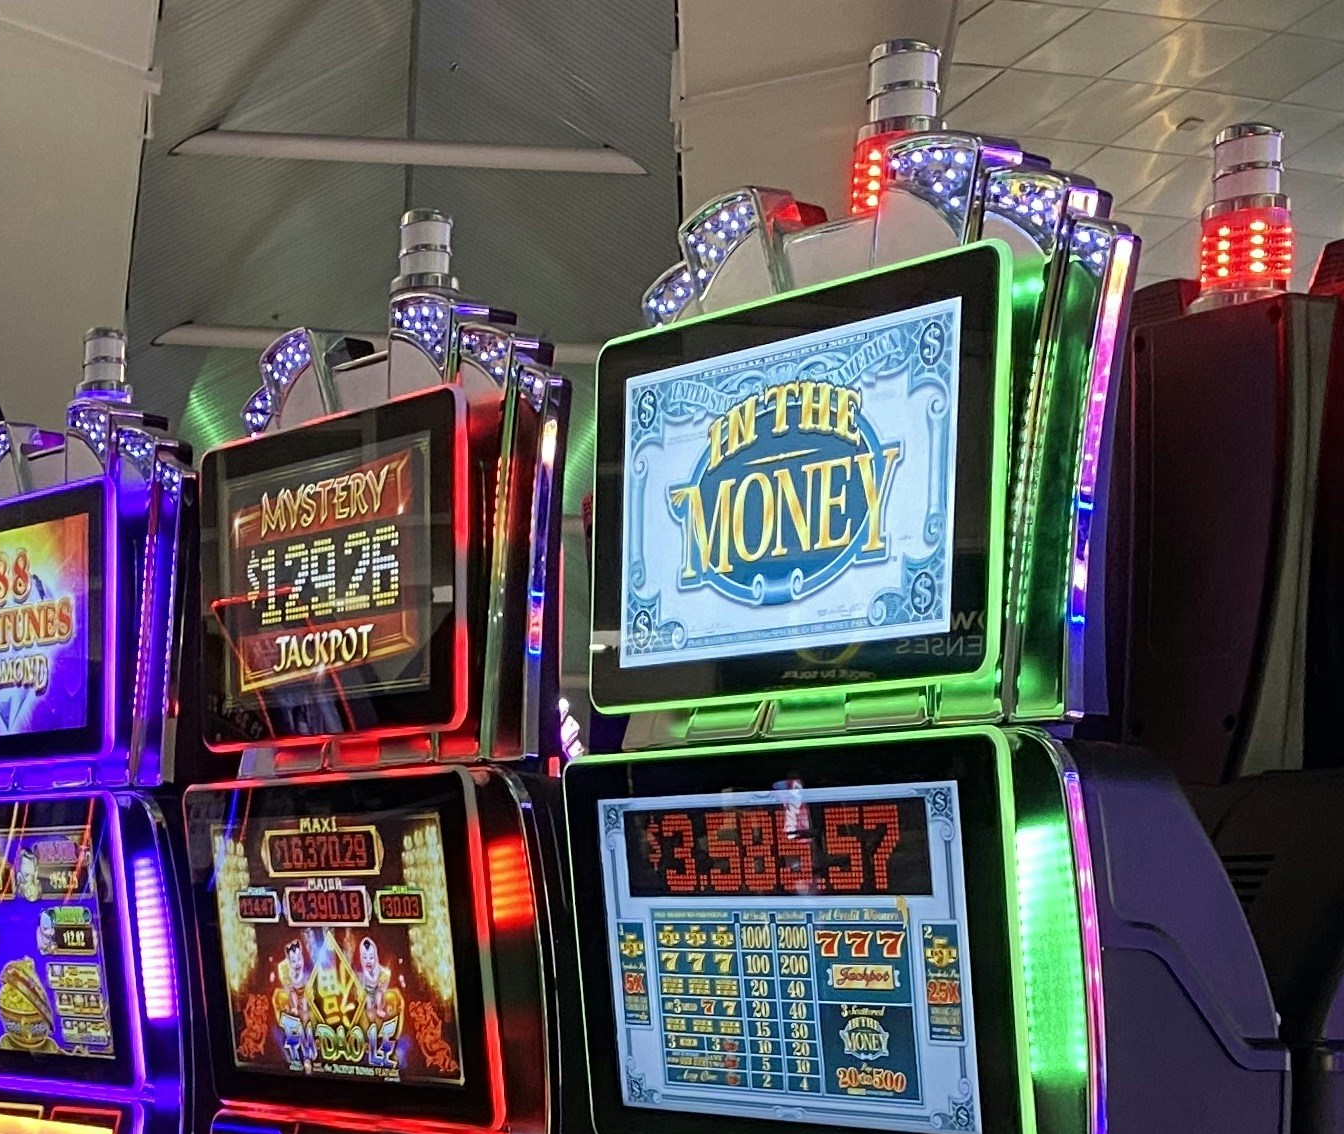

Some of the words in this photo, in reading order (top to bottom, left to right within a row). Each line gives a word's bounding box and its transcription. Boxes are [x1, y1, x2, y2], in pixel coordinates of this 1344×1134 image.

[707, 397, 760, 472] IN
[761, 380, 862, 443] THE
[260, 464, 389, 537] MYSTERY
[672, 446, 901, 579] MONEY
[247, 525, 399, 625] $129.26
[273, 623, 374, 673] JACKPOT
[300, 816, 338, 833] MAXI
[307, 877, 343, 892] MAJOR
[741, 925, 771, 950] 1000
[777, 925, 808, 950] 2000
[923, 925, 934, 939] 2
[815, 930, 843, 958] 7
[845, 930, 873, 958] 7
[876, 930, 906, 958] 7
[660, 951, 679, 973] 7
[686, 951, 706, 974] 7
[713, 952, 734, 974] 7
[745, 953, 771, 975] 100
[779, 954, 809, 976] 200
[624, 972, 646, 995] 5X
[836, 966, 891, 987] Jackpot
[750, 979, 769, 998] 20
[787, 980, 805, 999] 40
[927, 980, 960, 1004] 25X
[752, 1000, 771, 1019] 20
[788, 1001, 807, 1020] 40
[841, 1004, 849, 1017] 3
[755, 1020, 771, 1037] 15
[790, 1022, 809, 1040] 30
[316, 1022, 366, 1061] DAO
[758, 1039, 773, 1055] 10
[792, 1042, 811, 1058] 20
[847, 1031, 887, 1052] MONEY
[761, 1056, 771, 1072] 5
[795, 1058, 811, 1075] 10
[762, 1073, 772, 1089] 2
[799, 1075, 810, 1091] 4
[836, 1067, 860, 1088] 20
[871, 1068, 906, 1093] 500
